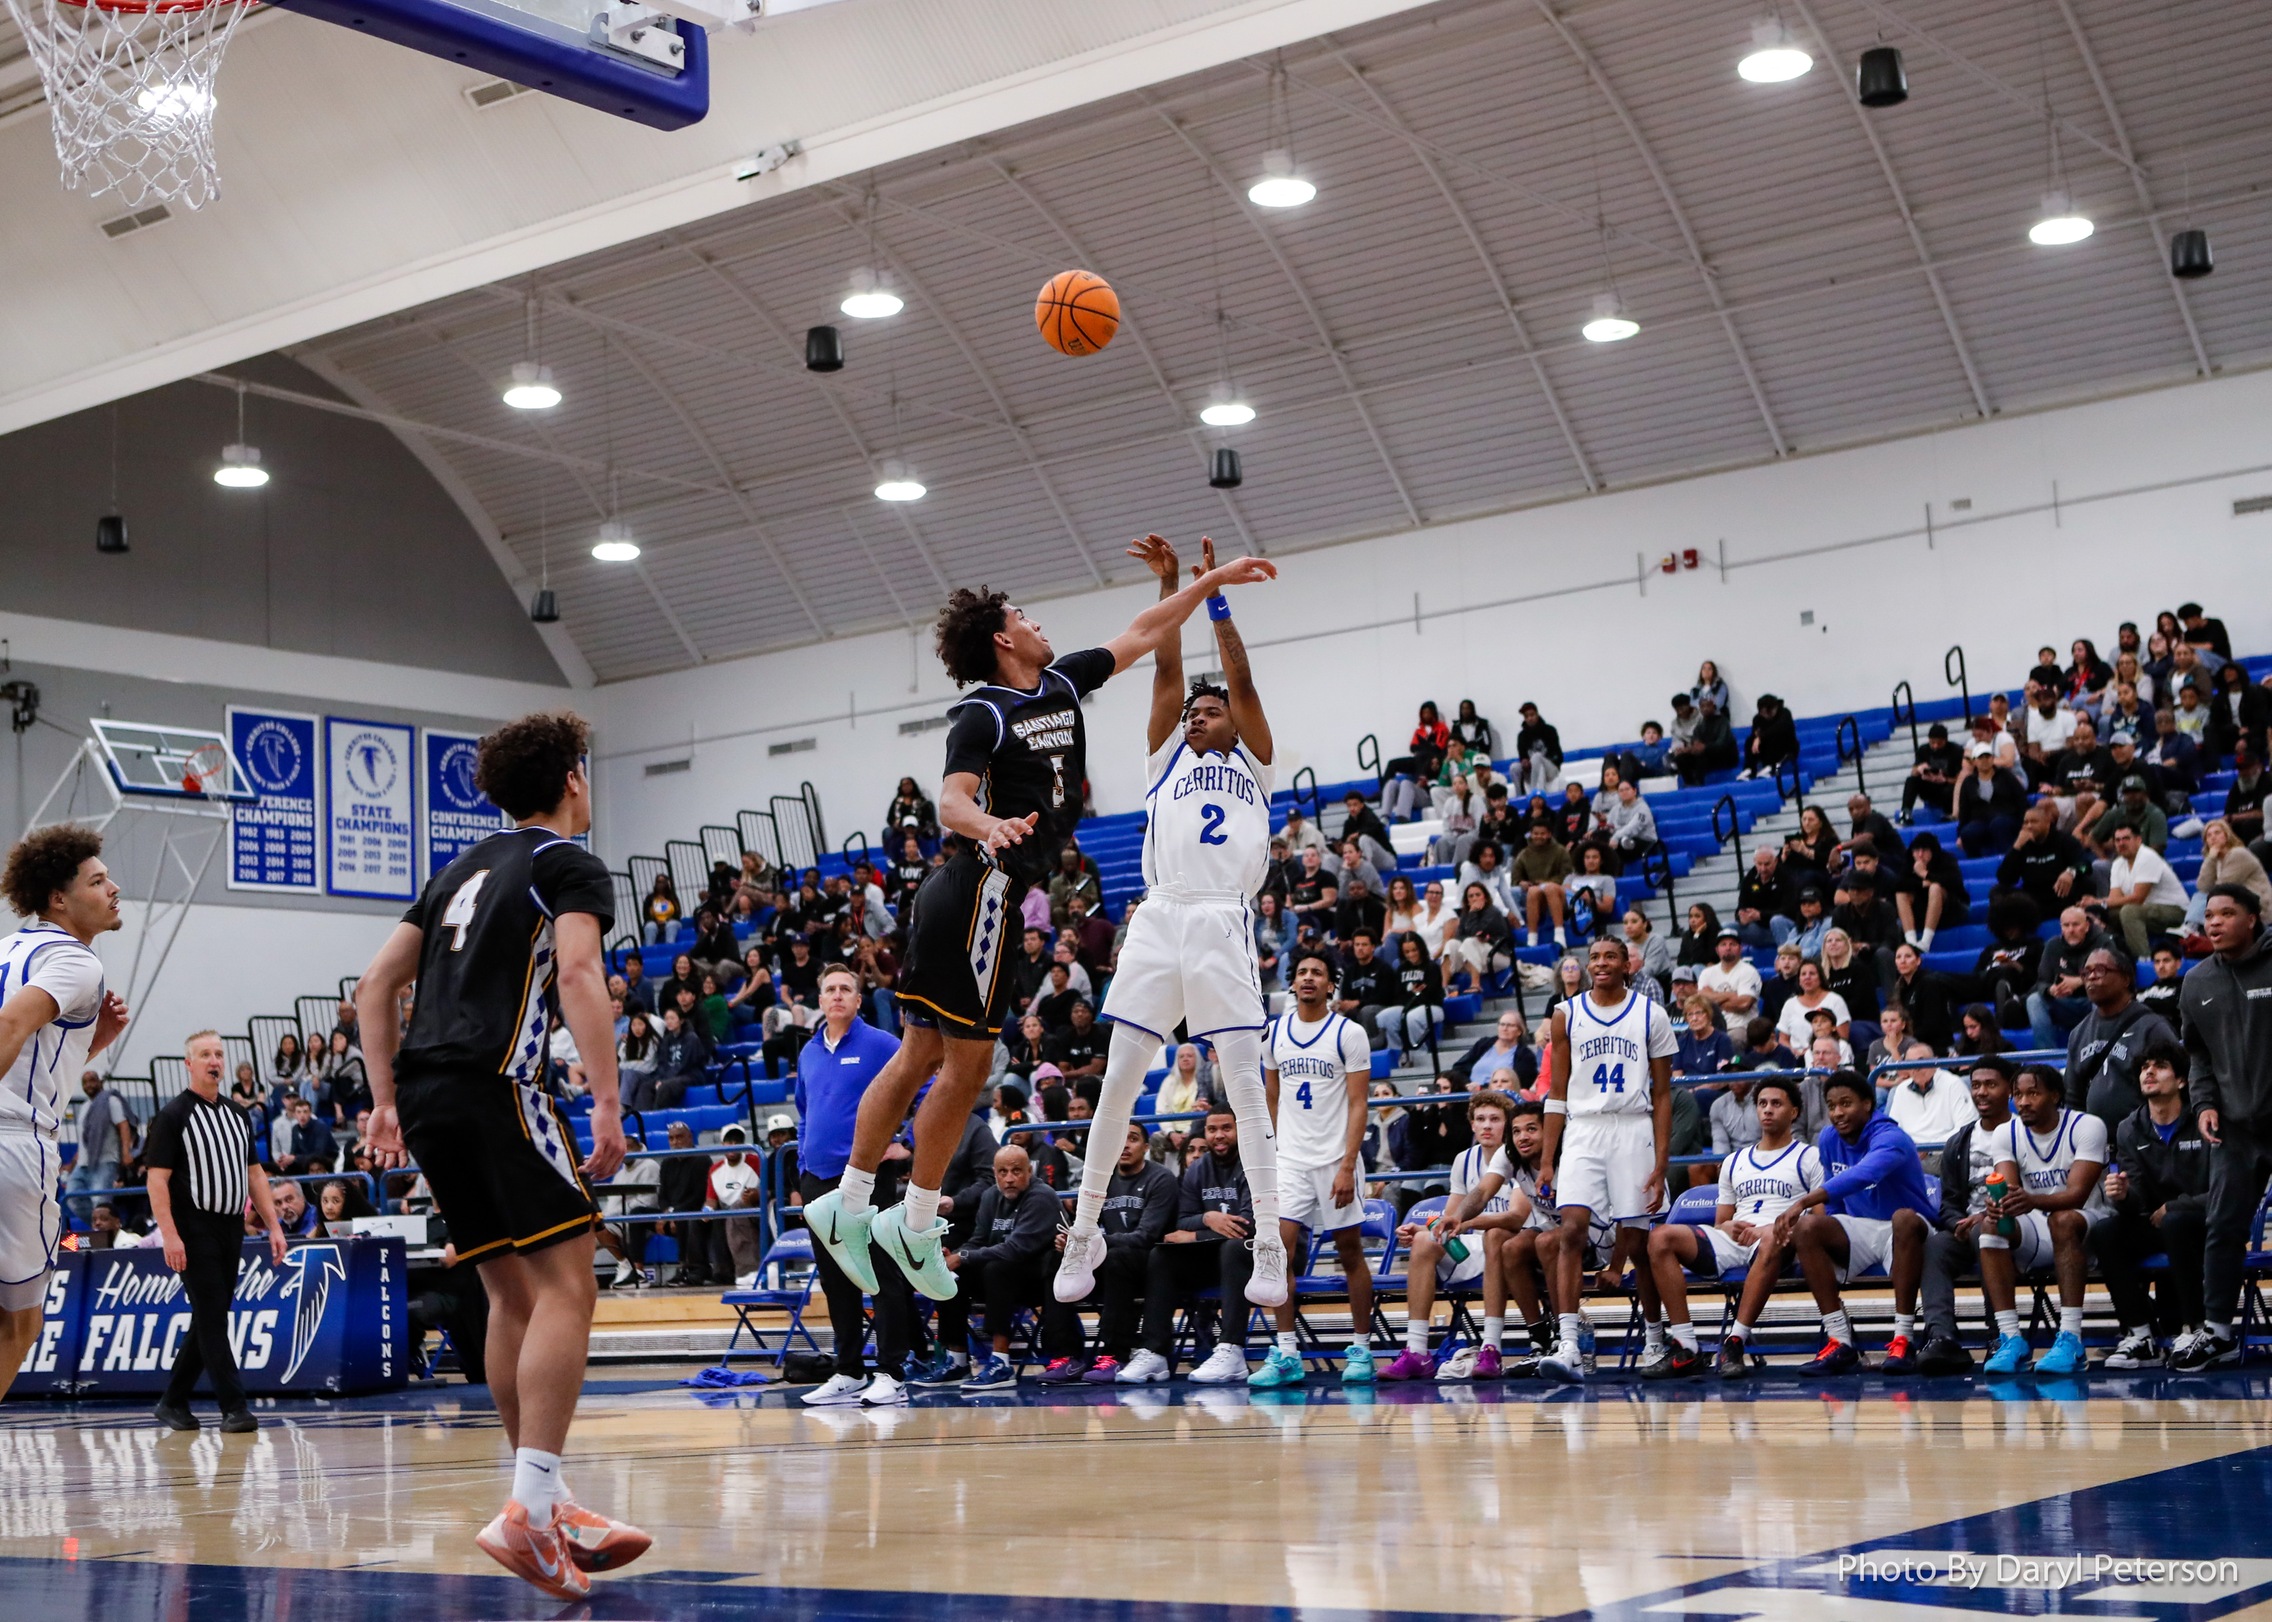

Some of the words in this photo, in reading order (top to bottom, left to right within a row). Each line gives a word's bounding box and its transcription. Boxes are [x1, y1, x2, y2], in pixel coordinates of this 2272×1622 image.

[1012, 709, 1075, 739] SANTIAGO
[1026, 727, 1075, 752] CANYON
[1174, 766, 1254, 806] CERRITOS
[250, 795, 313, 812] FERENCE
[352, 804, 392, 820] STATE
[236, 807, 313, 829] CHAMPIONS
[336, 818, 409, 836] CHAMPIONS
[431, 810, 500, 829] CONFERENCE
[1200, 803, 1228, 846] 2
[239, 826, 258, 838] 1982
[431, 825, 496, 842] CHAMPION
[238, 839, 259, 853] 2006
[239, 854, 259, 867] 2013
[265, 855, 285, 868] 2014
[239, 867, 259, 881] 2016
[266, 870, 285, 883] 2017
[441, 869, 491, 952] 4
[1580, 1036, 1638, 1062] CERRITOS
[1593, 1063, 1625, 1093] 44
[1296, 1081, 1312, 1110] 4
[1364, 1211, 1385, 1221] ollege
[1412, 1209, 1440, 1218] Cerritos
[95, 1260, 183, 1310] Home
[379, 1248, 392, 1378] FALCONS
[79, 1309, 279, 1372] FALCNS
